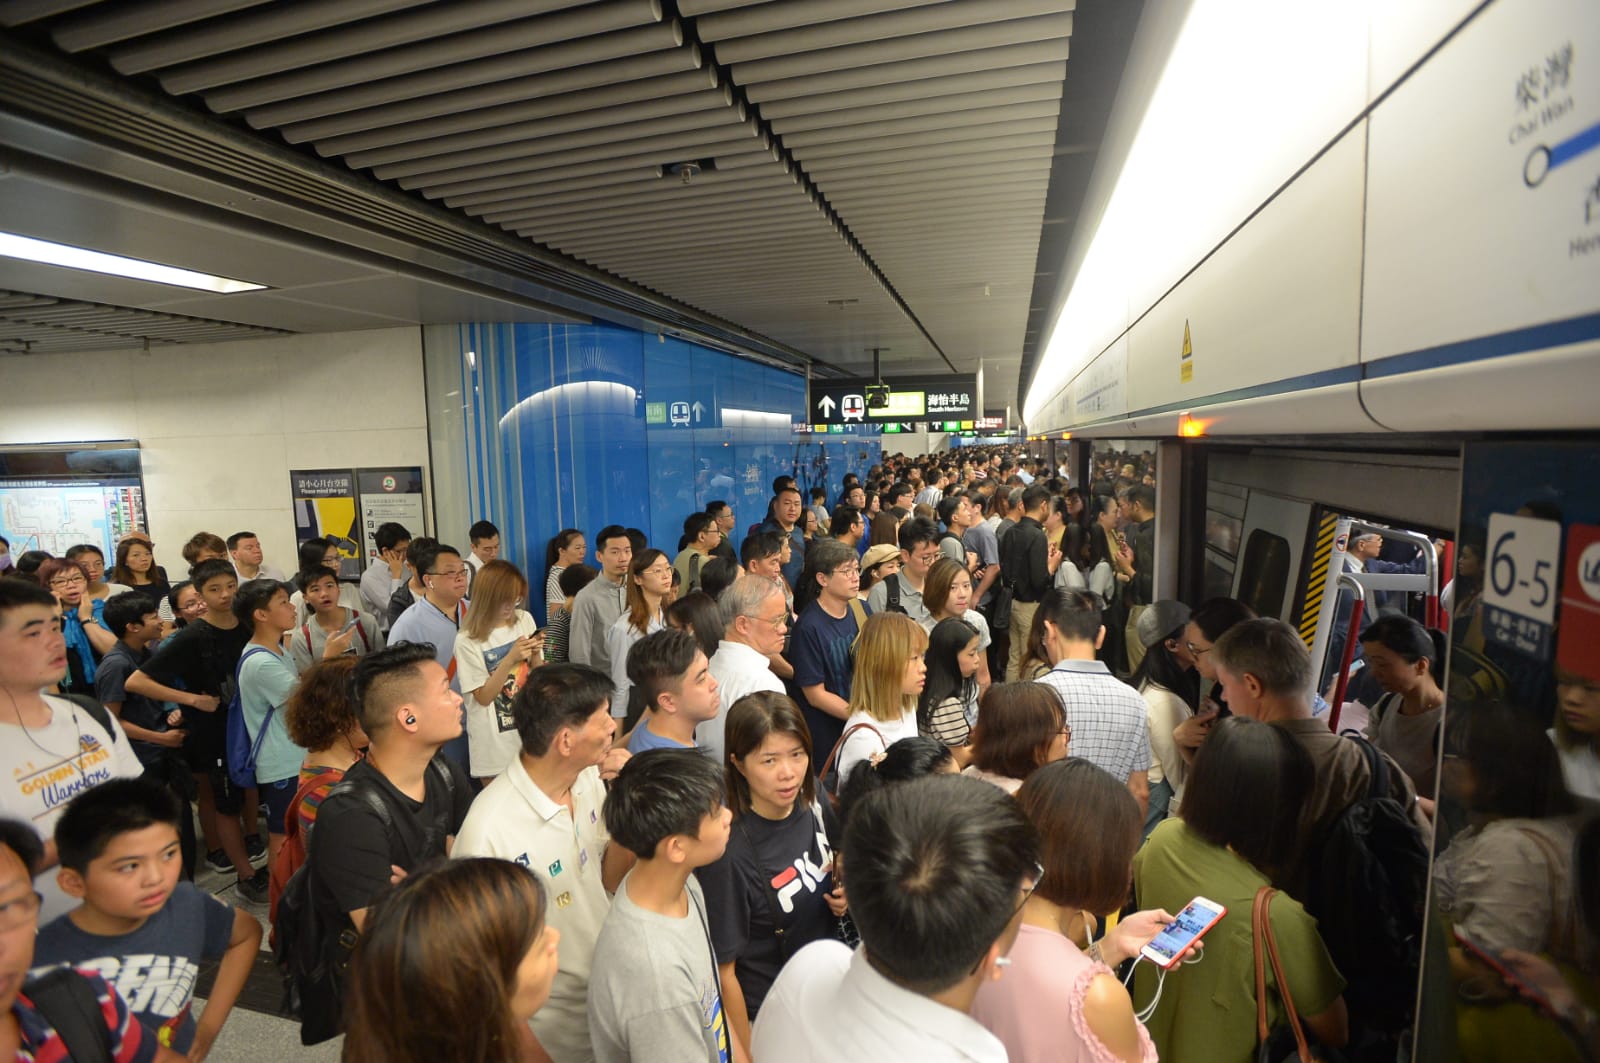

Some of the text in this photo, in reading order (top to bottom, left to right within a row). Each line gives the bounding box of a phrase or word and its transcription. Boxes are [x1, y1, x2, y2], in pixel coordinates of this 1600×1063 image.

[1490, 530, 1552, 608] 6-5
[20, 764, 75, 795] GOLDEN
[42, 766, 111, 808] Warriors
